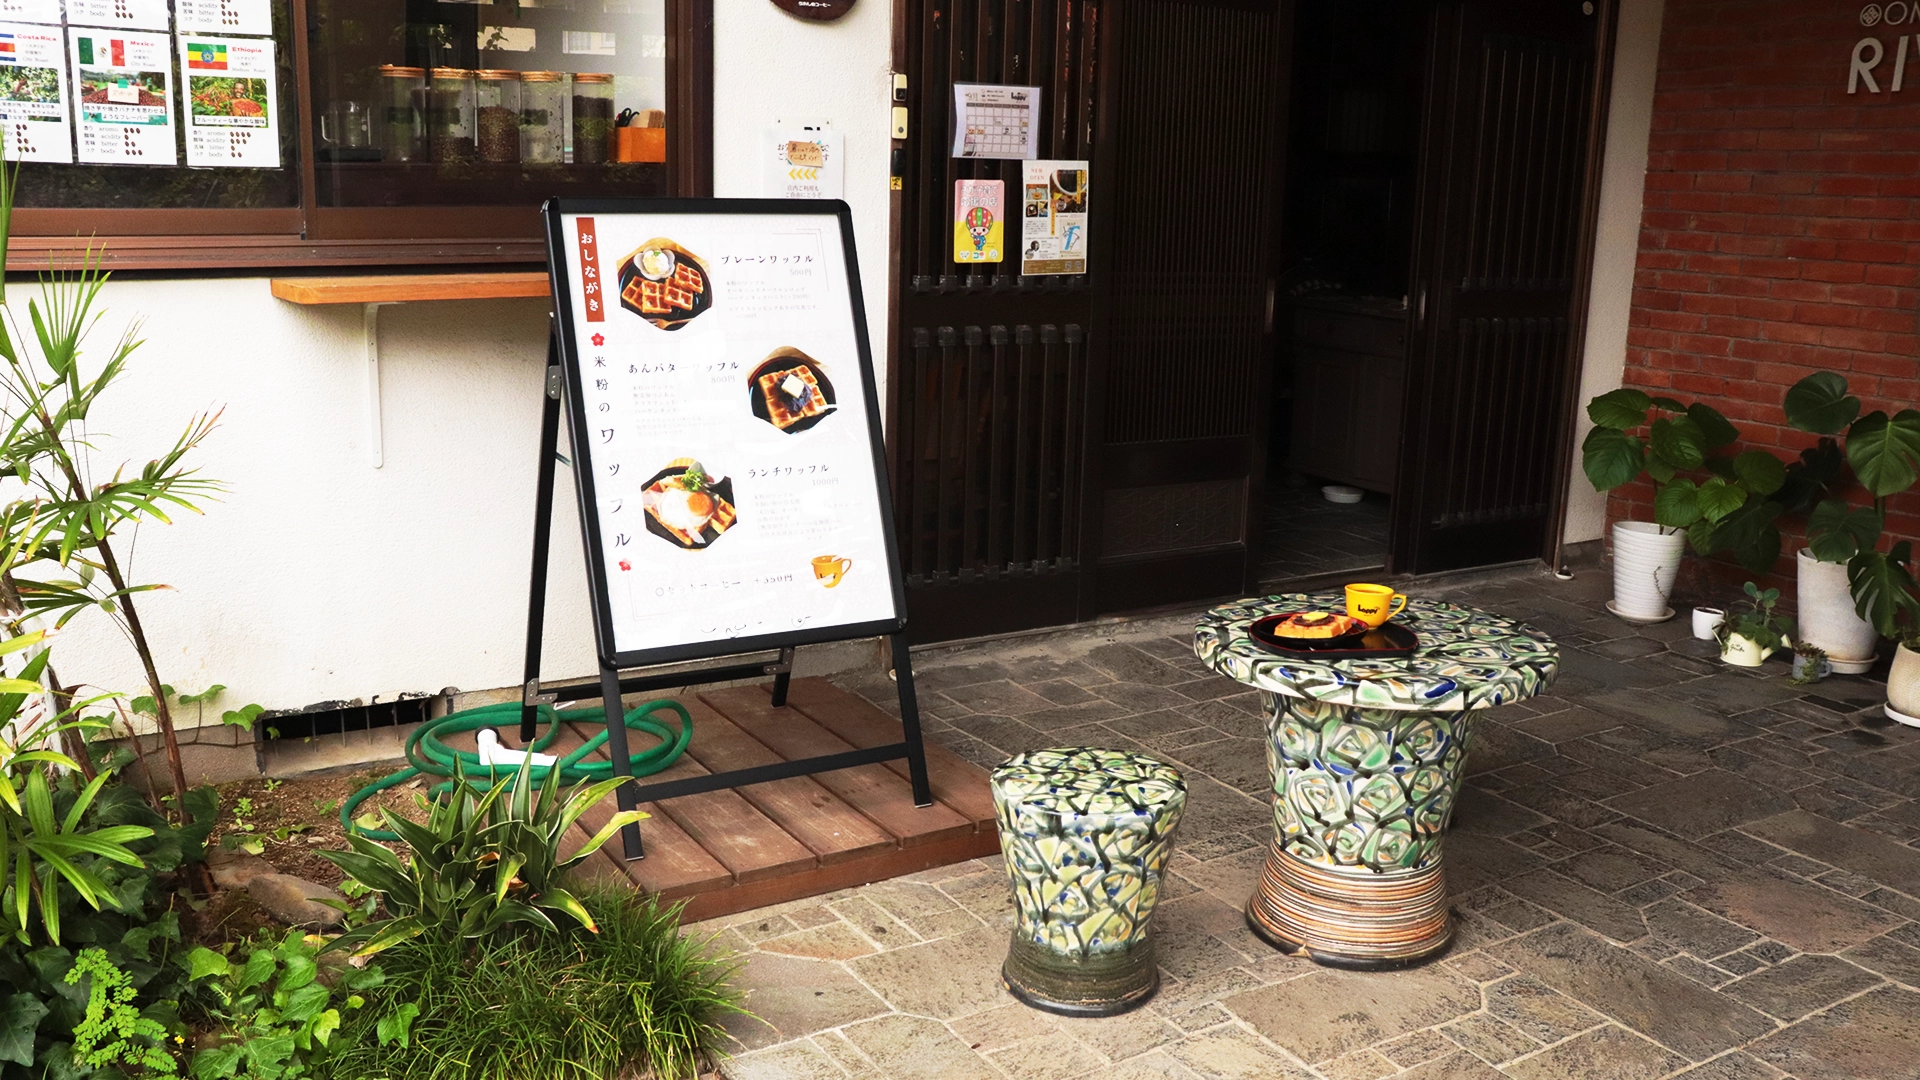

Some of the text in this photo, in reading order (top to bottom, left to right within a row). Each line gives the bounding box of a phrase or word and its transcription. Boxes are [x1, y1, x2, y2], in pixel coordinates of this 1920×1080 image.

[17, 33, 39, 41] Costa
[1847, 34, 1920, 94] RI
[580, 232, 600, 313] おしながき
[789, 268, 812, 276] 500円
[710, 375, 736, 384] 800円
[748, 464, 830, 479] ランチワッフル
[812, 477, 839, 486] 1000円
